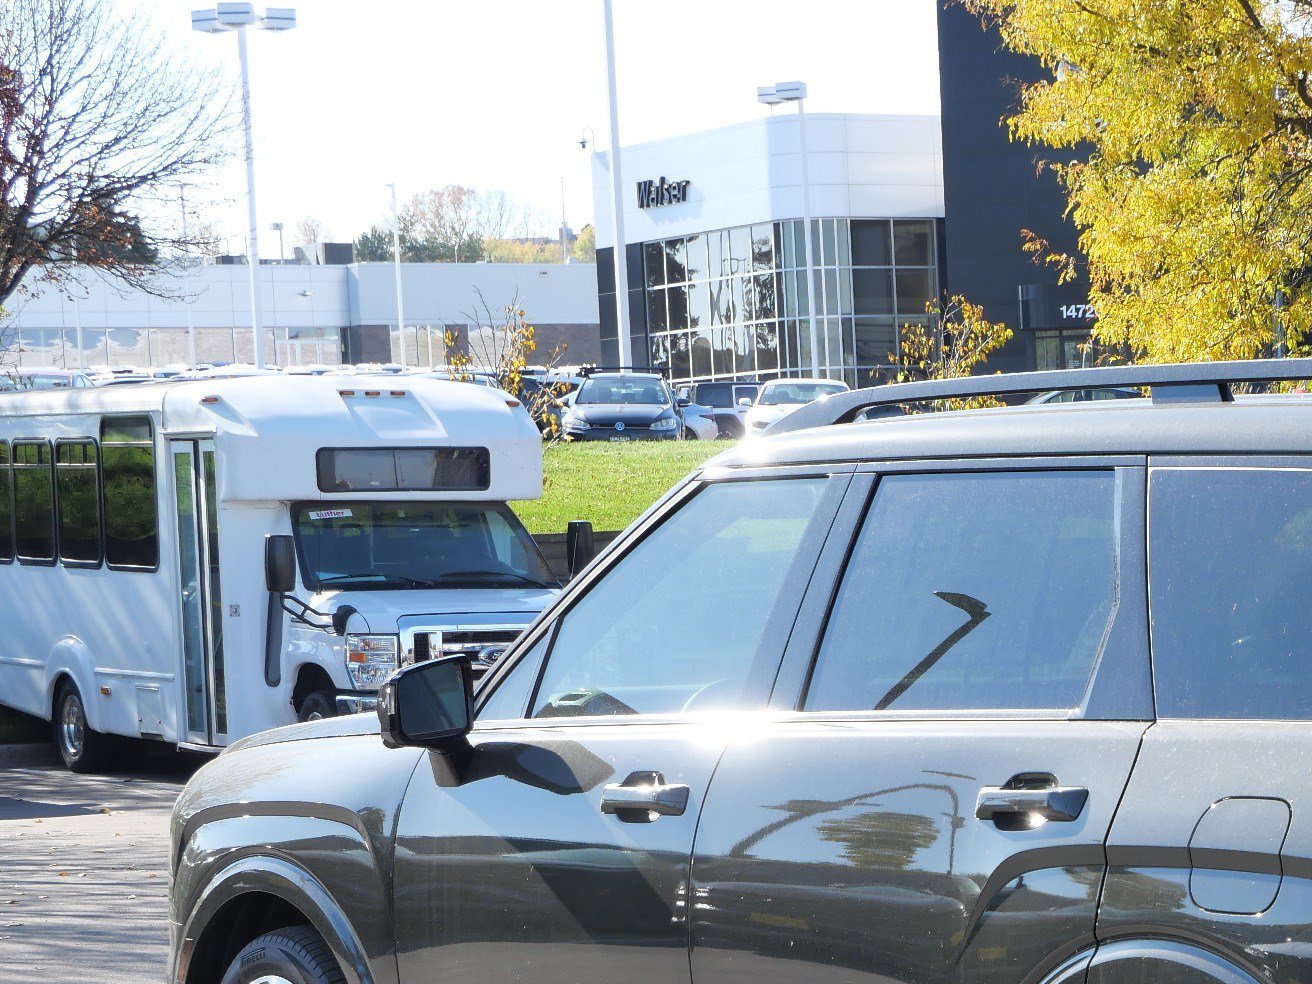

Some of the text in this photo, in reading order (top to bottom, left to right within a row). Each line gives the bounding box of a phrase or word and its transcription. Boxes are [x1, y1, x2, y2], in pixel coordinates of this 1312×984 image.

[636, 176, 690, 210] Walser
[1060, 304, 1094, 319] 1472
[241, 947, 266, 967] PIRELLI
